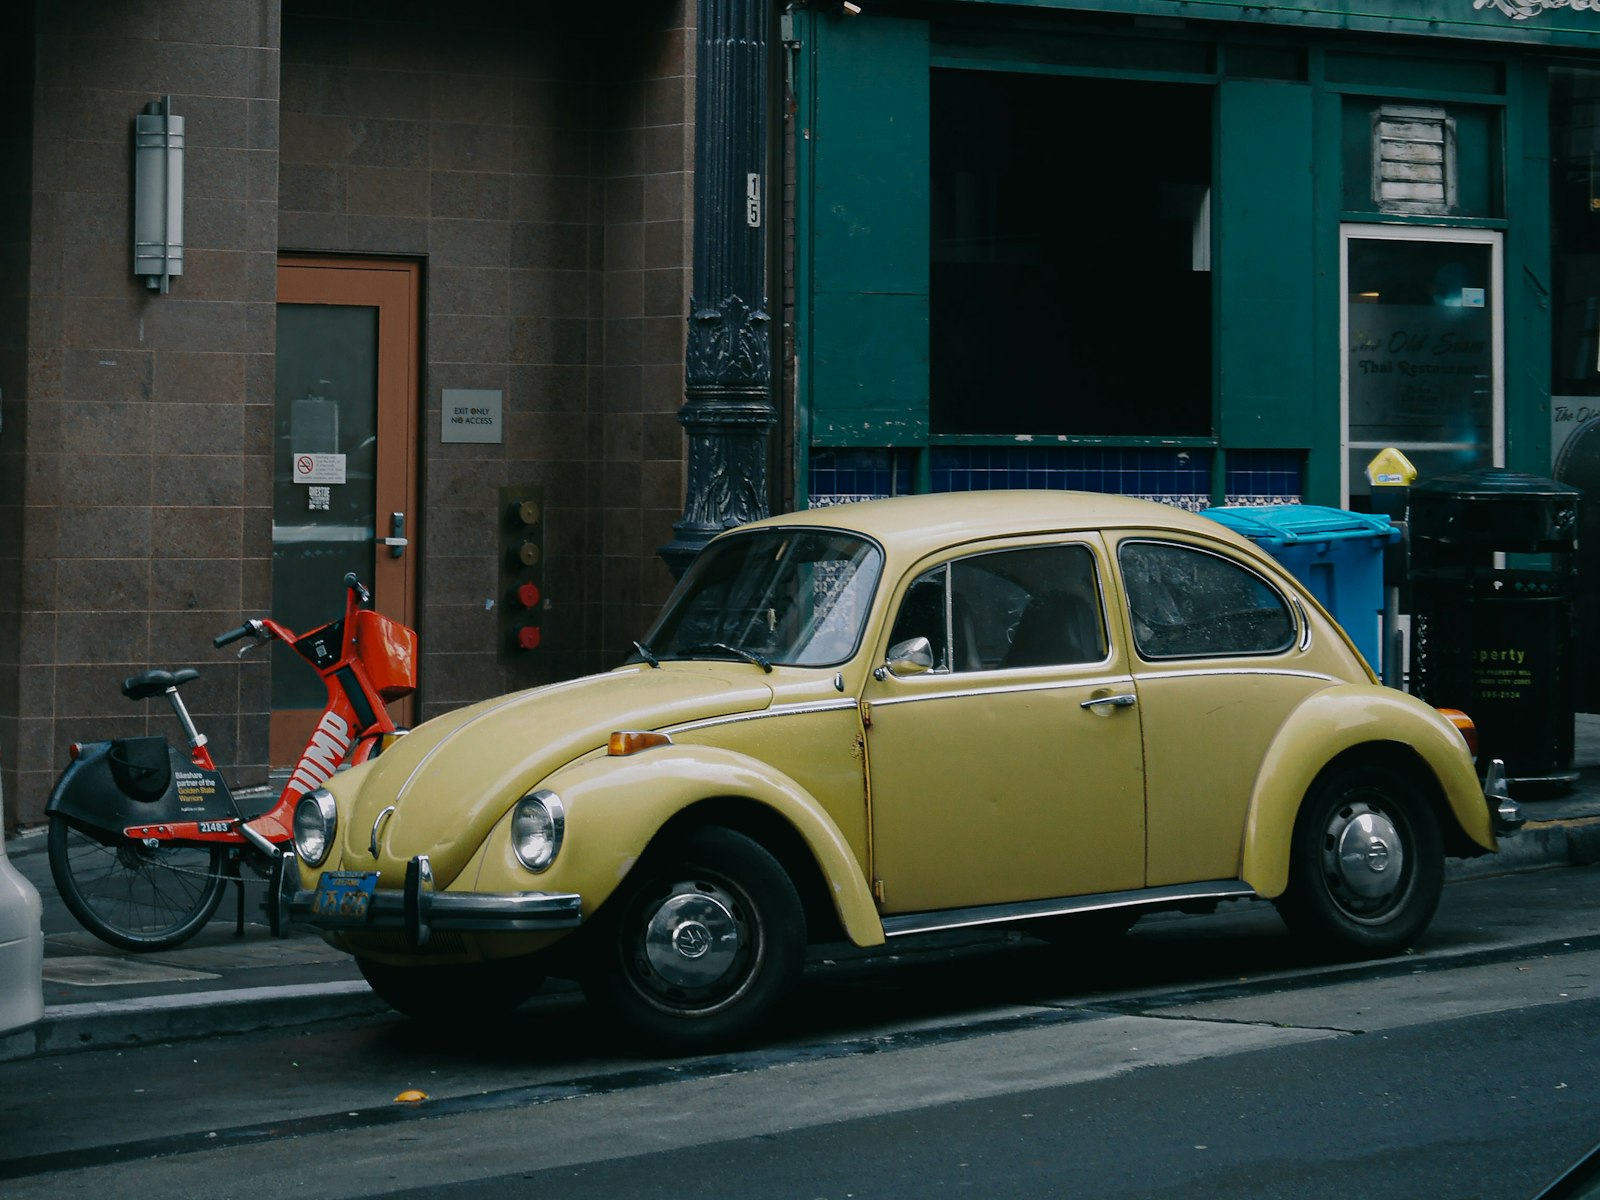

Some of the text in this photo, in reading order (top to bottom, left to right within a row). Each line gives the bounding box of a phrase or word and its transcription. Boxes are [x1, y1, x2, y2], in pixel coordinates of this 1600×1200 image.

[1358, 360, 1392, 375] Thai
[470, 407, 489, 415] ONLY
[1555, 406, 1574, 422] The
[198, 779, 205, 787] of
[177, 787, 199, 795] Golden
